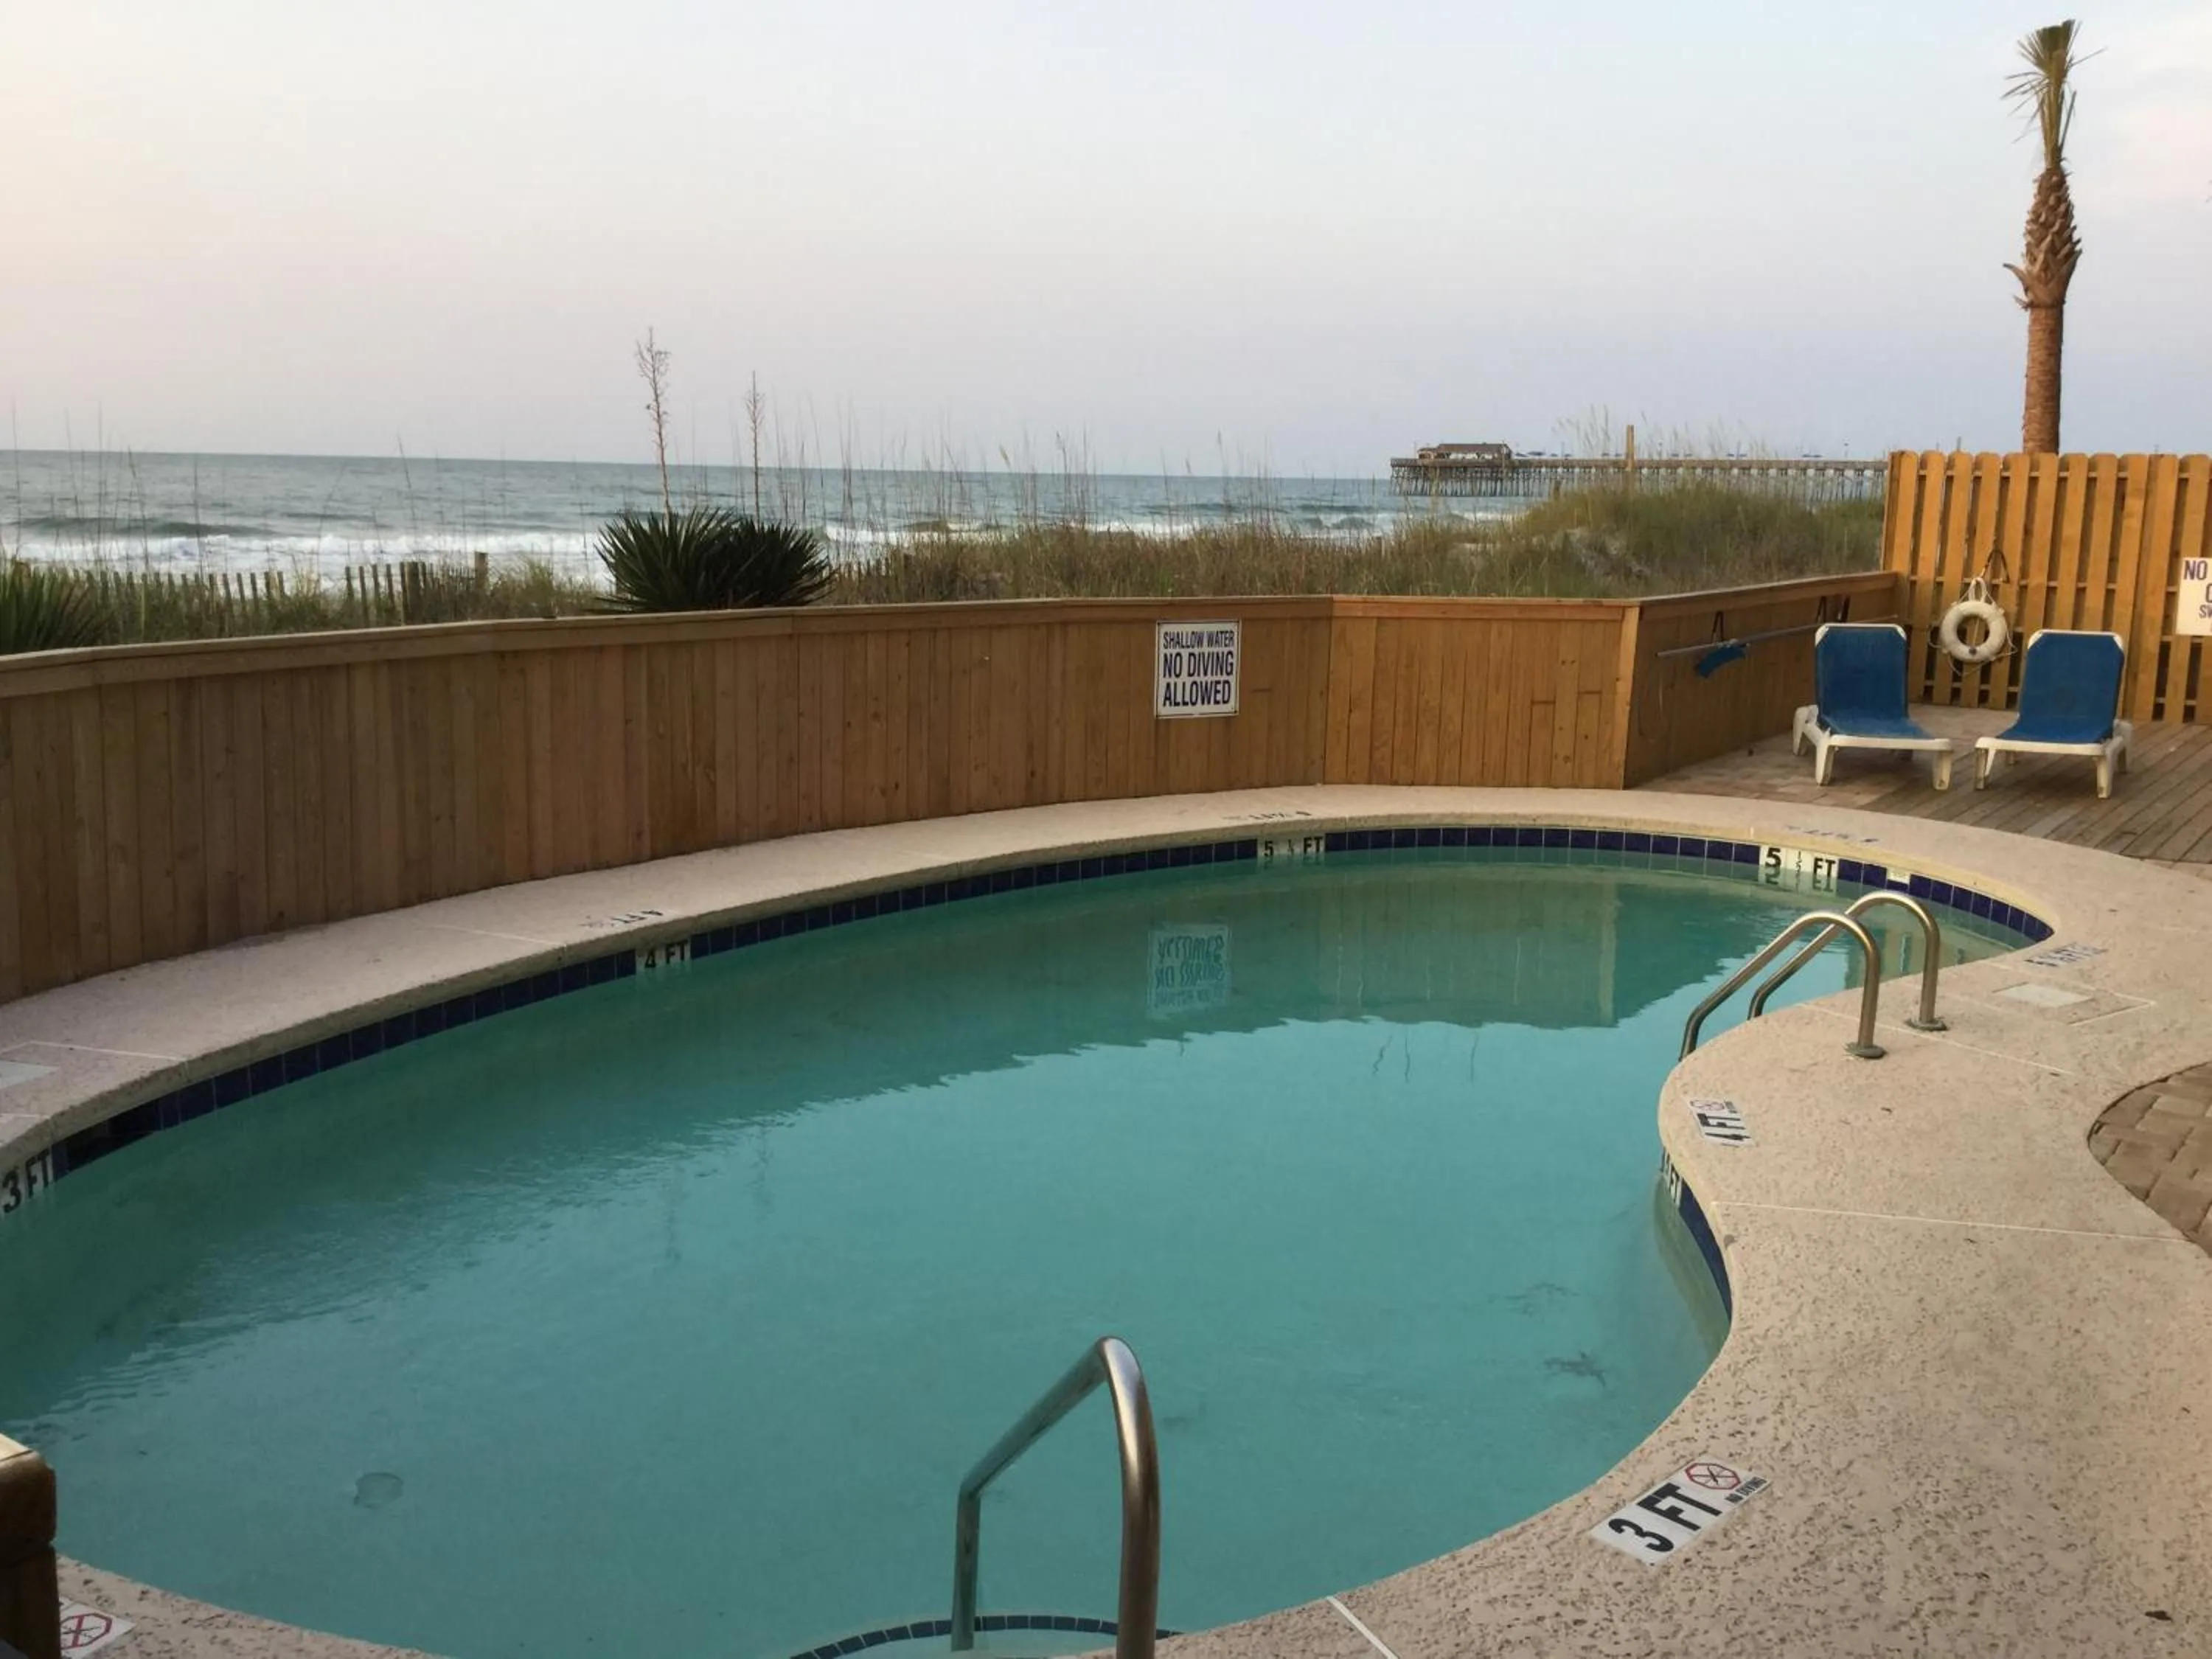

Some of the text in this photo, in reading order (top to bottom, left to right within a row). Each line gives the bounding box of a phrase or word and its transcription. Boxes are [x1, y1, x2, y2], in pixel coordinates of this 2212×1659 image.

[2183, 560, 2208, 580] NO
[1163, 630, 1234, 649] SHALLOW WATER
[1163, 650, 1234, 678] NO DIVING
[1162, 680, 1231, 707] ALLOWED
[1304, 836, 1323, 854] FT
[1765, 847, 1781, 868] 5
[1814, 857, 1836, 877] FT
[666, 939, 688, 964] FT
[2, 1147, 49, 1214] 3 FT
[1608, 1482, 1723, 1553] 3 FT
